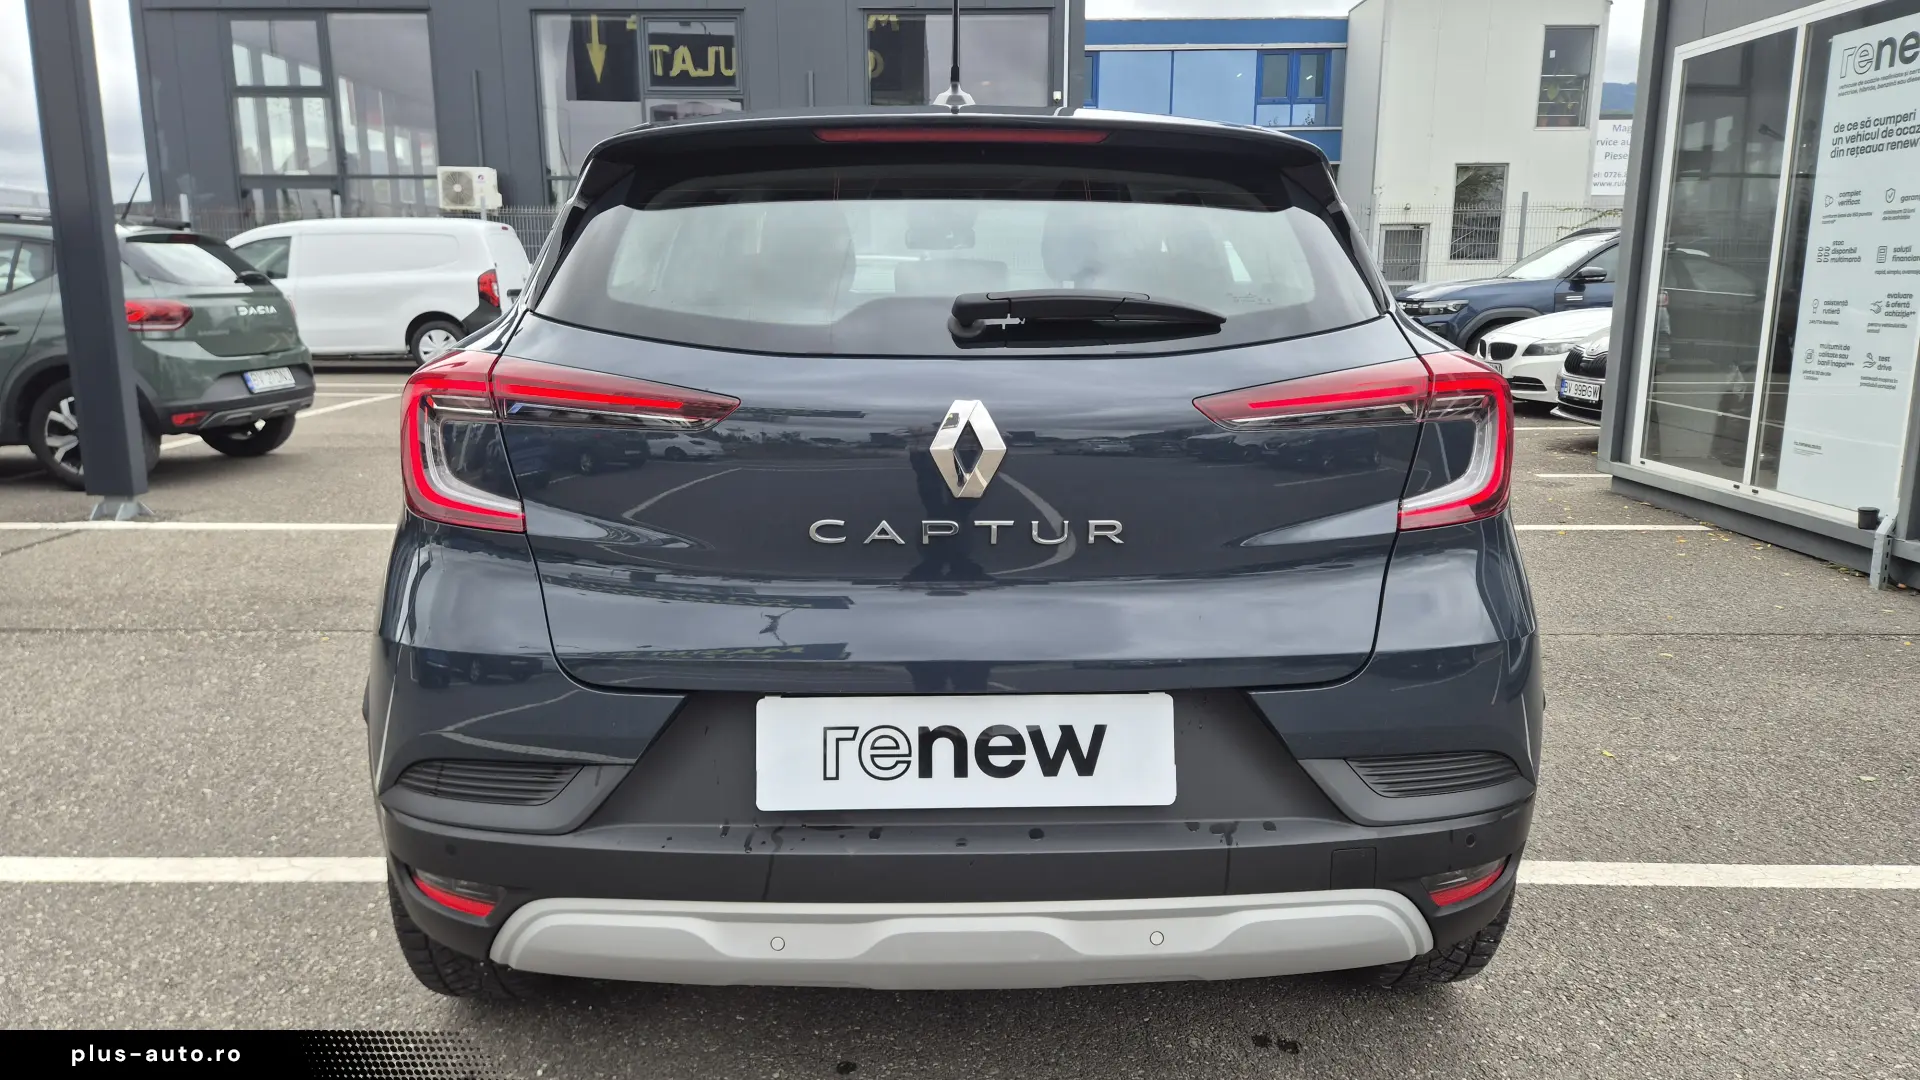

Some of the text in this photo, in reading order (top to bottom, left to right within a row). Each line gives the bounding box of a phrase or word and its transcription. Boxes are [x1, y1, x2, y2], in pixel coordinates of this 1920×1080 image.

[1834, 108, 1916, 134] de ce să cumperi
[1832, 136, 1844, 146] un
[1846, 128, 1879, 145] vehicul
[1881, 126, 1894, 138] de
[1604, 152, 1628, 160] Piese
[1830, 146, 1844, 159] din
[1846, 143, 1884, 158] rețeaua
[237, 306, 277, 316] DACIA
[809, 519, 1124, 545] CAPTUR
[823, 724, 1108, 781] renew
